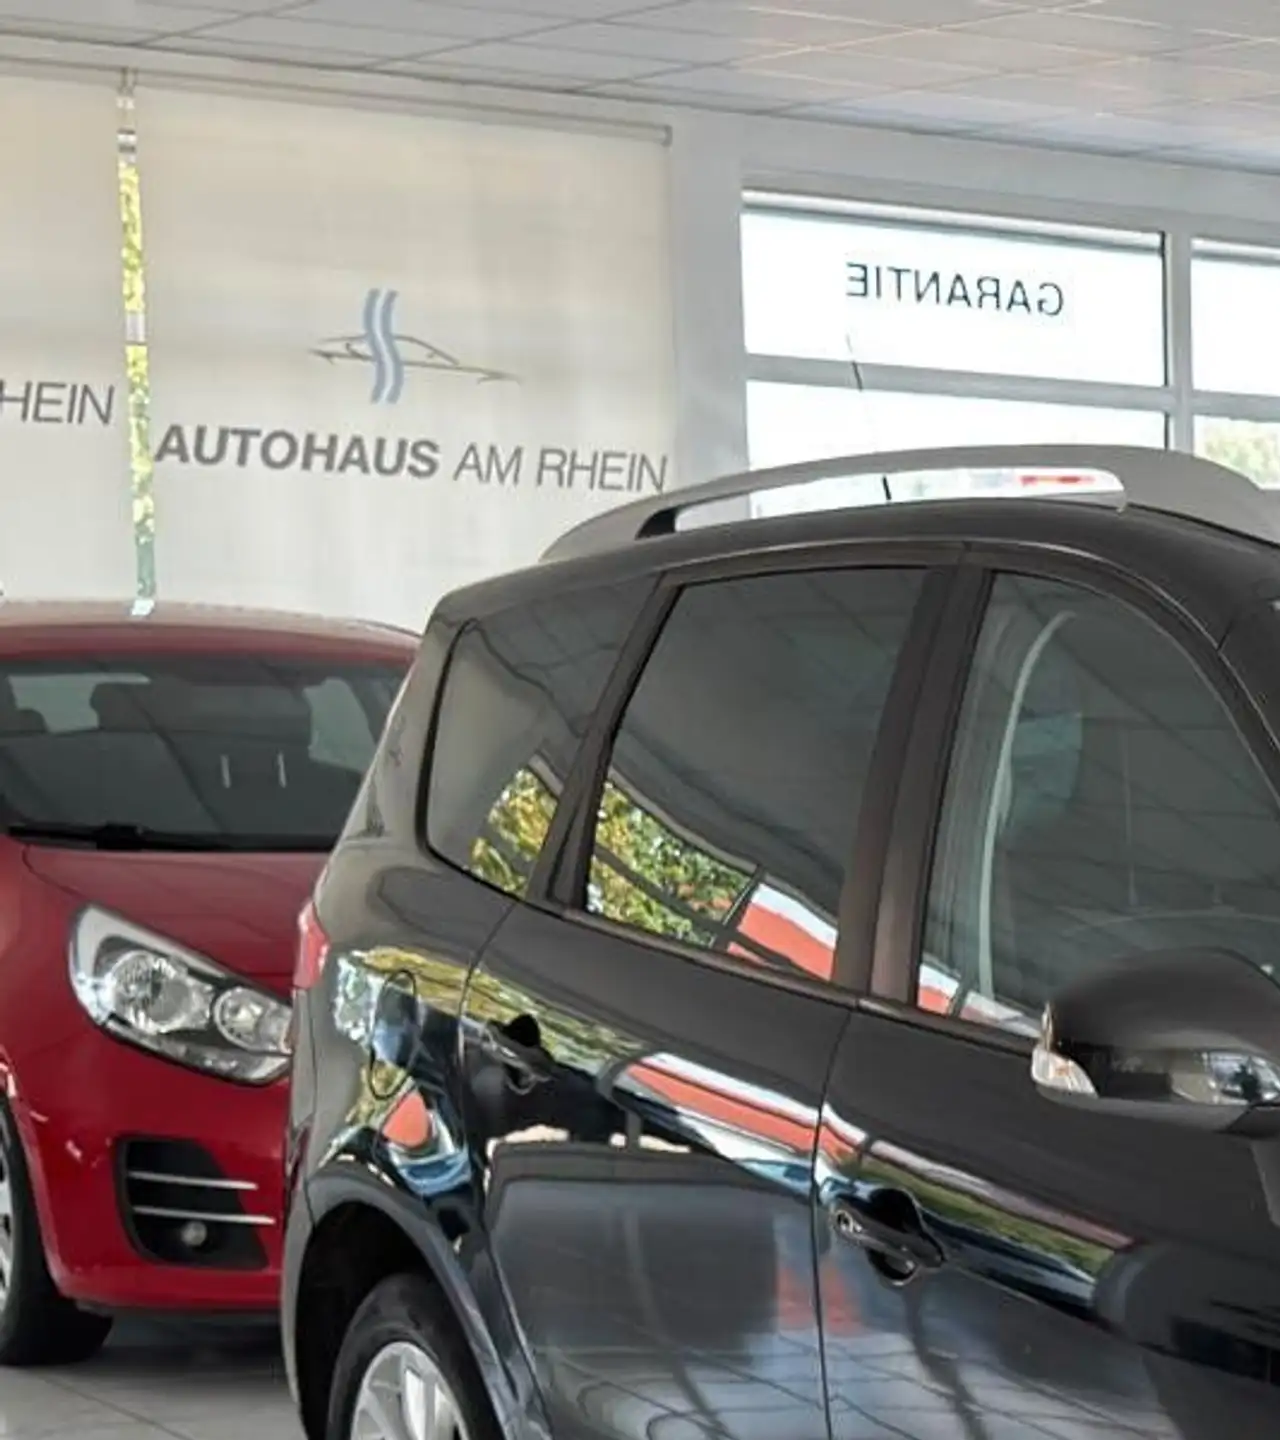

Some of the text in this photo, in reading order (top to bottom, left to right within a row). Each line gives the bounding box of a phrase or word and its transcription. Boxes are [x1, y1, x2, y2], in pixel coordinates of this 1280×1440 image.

[153, 423, 668, 496] AUTOHAUS AM RHEIN
